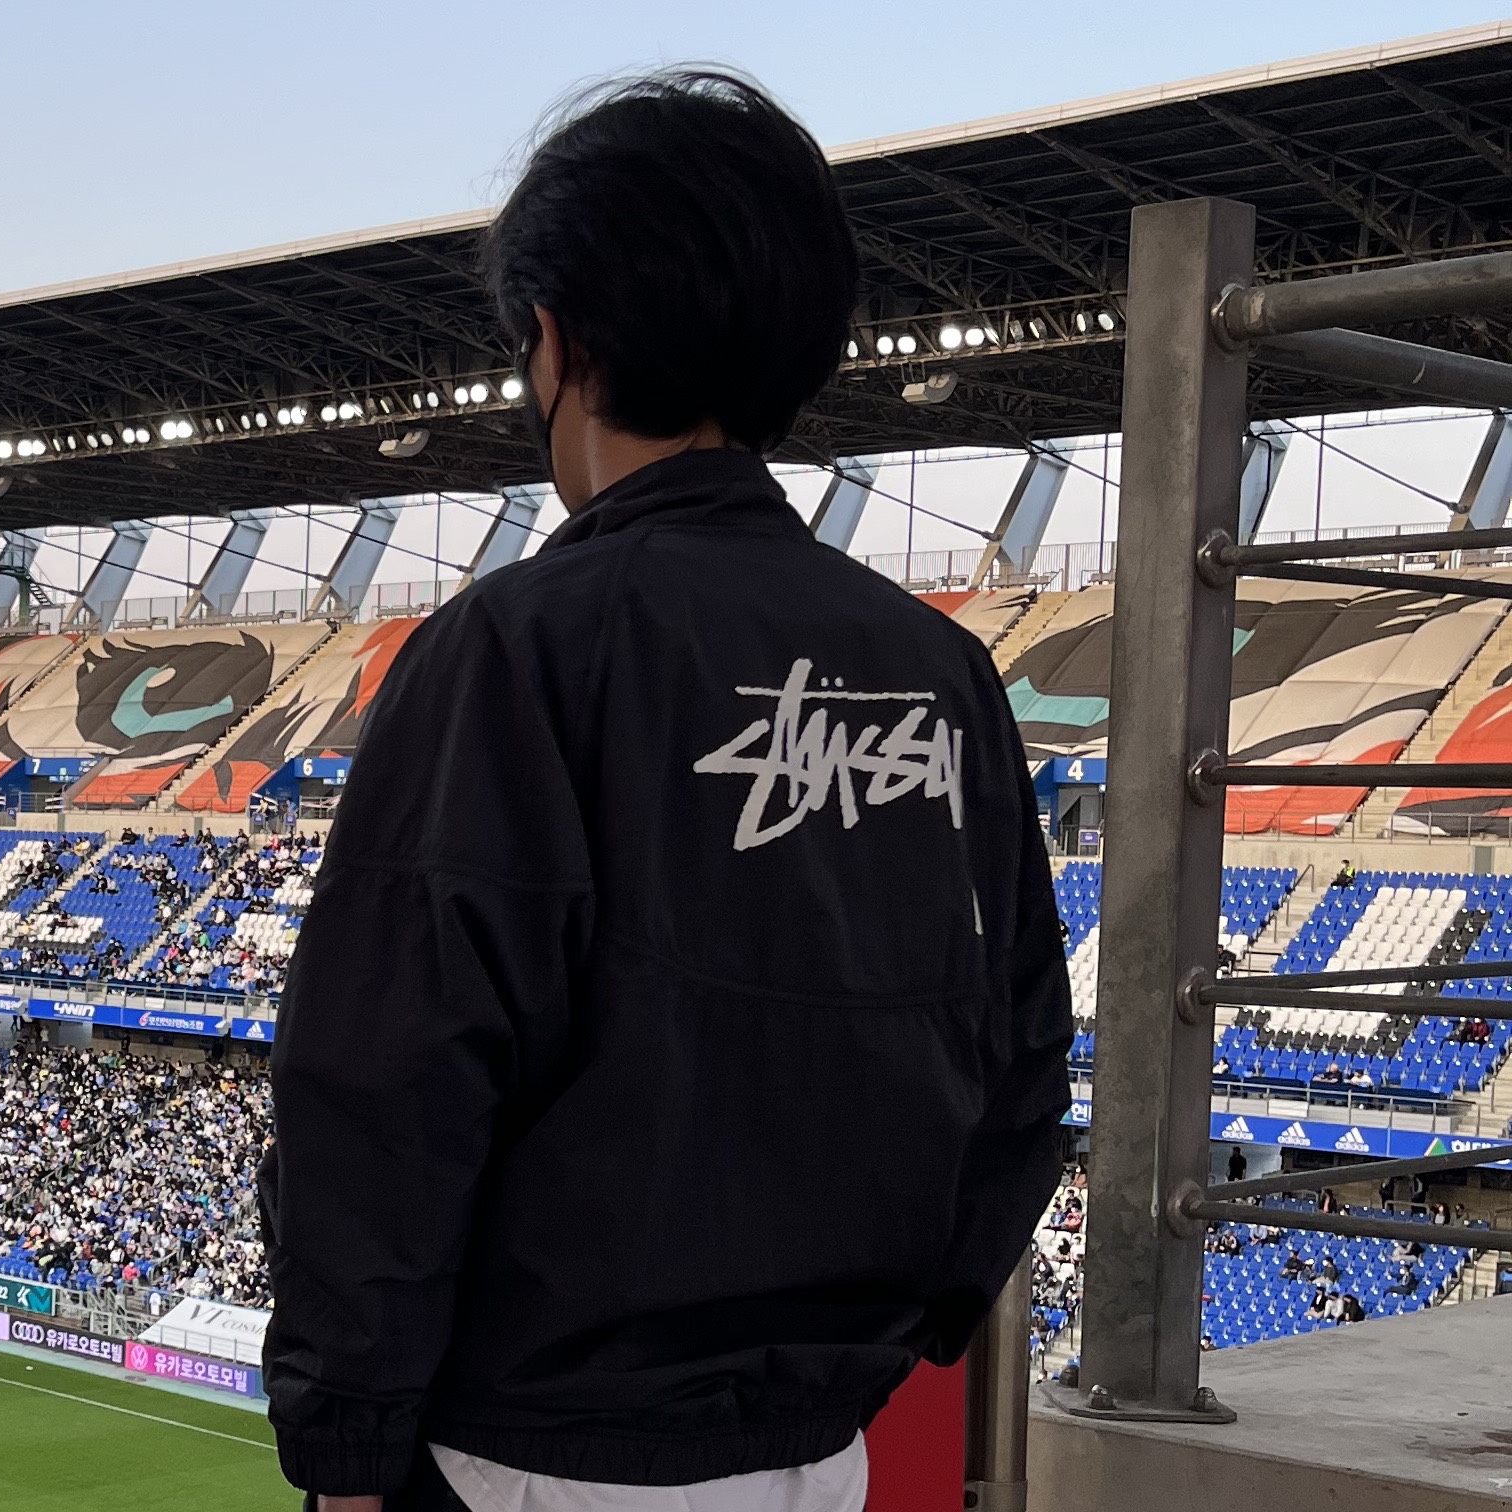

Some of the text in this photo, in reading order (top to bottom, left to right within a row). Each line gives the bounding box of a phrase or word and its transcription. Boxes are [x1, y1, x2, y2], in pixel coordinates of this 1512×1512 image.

[31, 759, 40, 773] 7
[302, 758, 313, 775] 6
[1068, 760, 1084, 780] 4
[1221, 1130, 1254, 1141] adidas
[1277, 1135, 1311, 1147] adidas
[1335, 1141, 1370, 1152] adidas
[188, 1304, 232, 1325] VT
[46, 1330, 123, 1364] 유카로오토모빌
[153, 1352, 248, 1393] 유카로오토모빌
